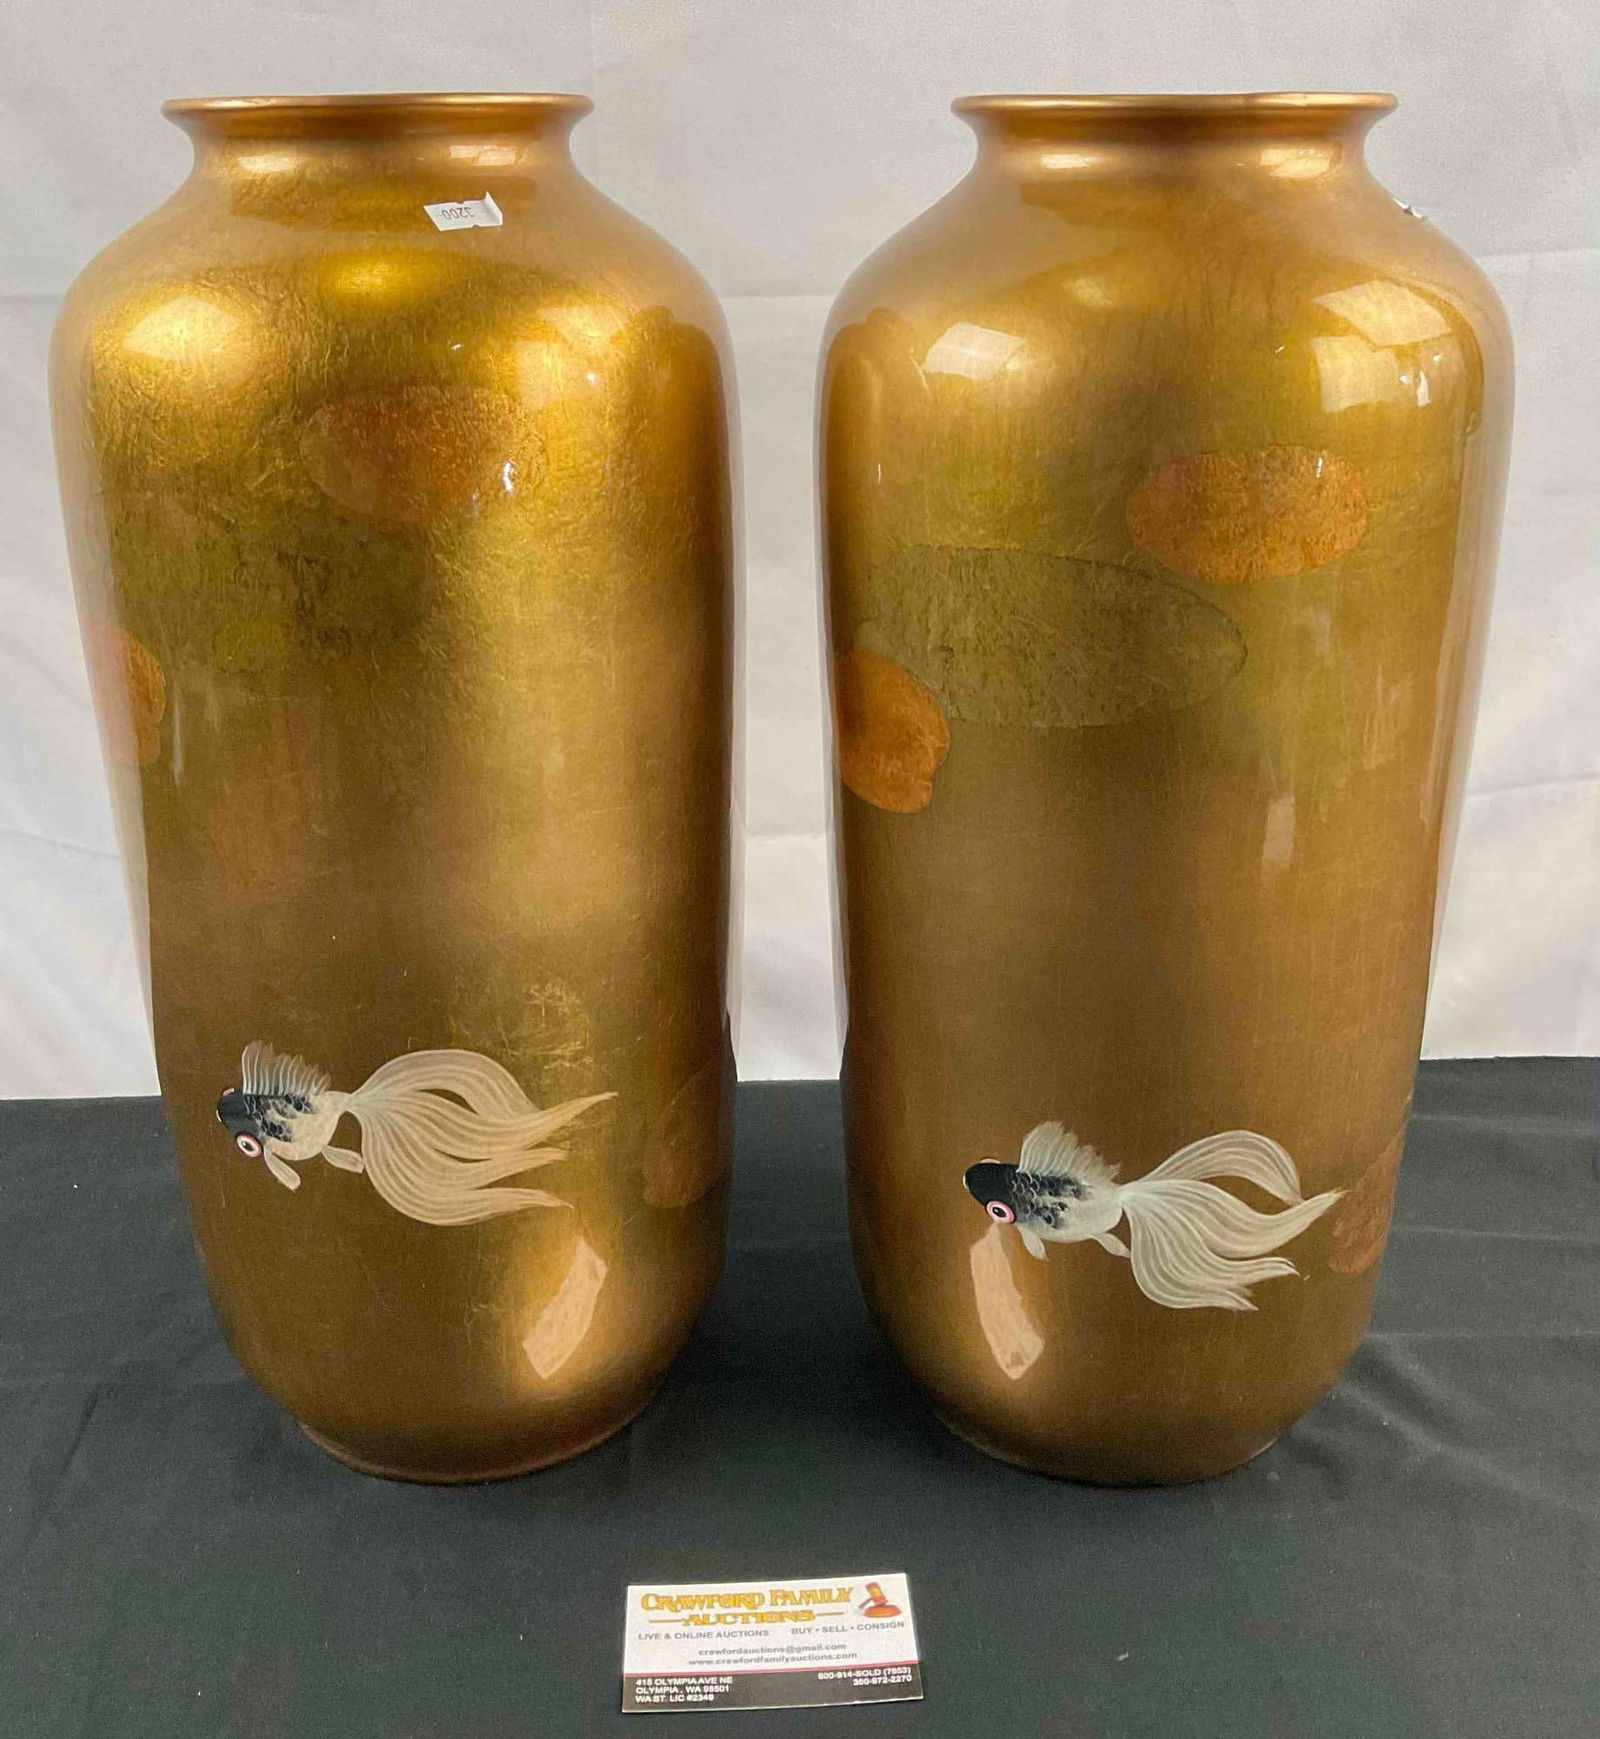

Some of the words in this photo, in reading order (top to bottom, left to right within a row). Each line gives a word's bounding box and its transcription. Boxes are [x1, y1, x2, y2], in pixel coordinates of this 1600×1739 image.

[641, 1593, 765, 1612] CRAWFORD
[769, 1588, 853, 1605] FAMILY
[682, 1610, 816, 1626] AUCTIONS
[791, 1627, 813, 1635] BUY
[822, 1625, 847, 1633] SELL
[857, 1621, 905, 1631] CONSIGN
[638, 1632, 662, 1640] LIVE
[664, 1632, 672, 1640] &
[674, 1631, 714, 1640] ONLINE
[716, 1629, 770, 1638] AUCTIONS
[698, 1644, 847, 1655] crawfordauctions@gmail.com
[688, 1653, 858, 1665] www.crawfordfamilyauctions.com
[654, 1677, 698, 1686] OLYMPIA
[719, 1675, 733, 1684] NE
[685, 1686, 702, 1694] WA
